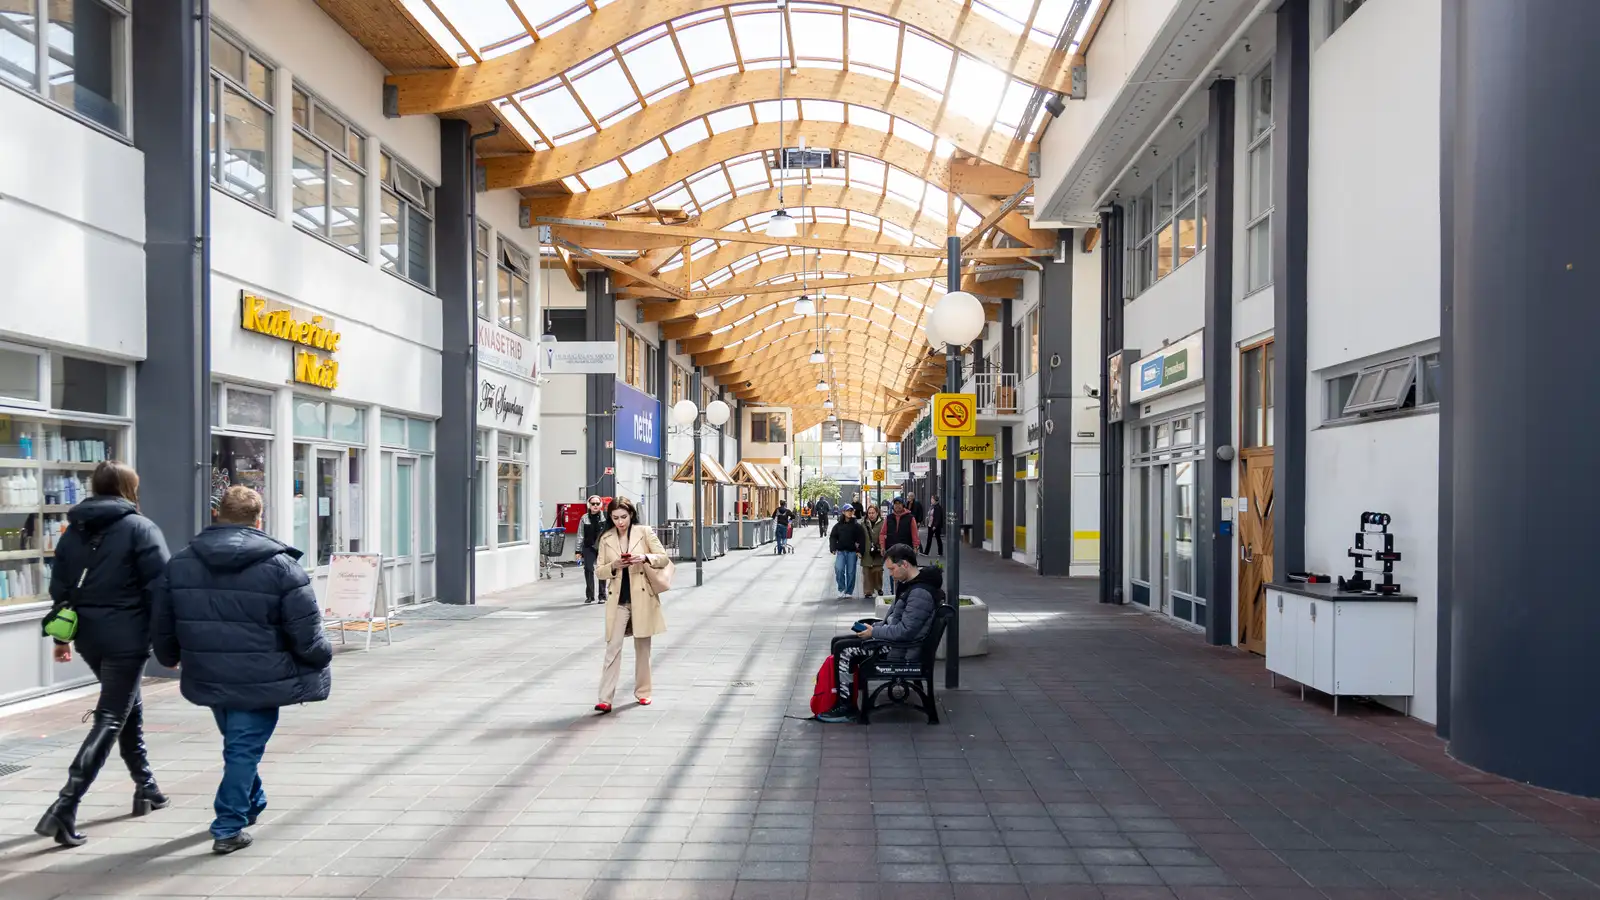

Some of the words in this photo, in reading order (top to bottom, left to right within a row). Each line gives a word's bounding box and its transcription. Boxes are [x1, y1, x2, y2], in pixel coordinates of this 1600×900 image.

[243, 294, 341, 352] Katherine
[296, 350, 339, 390] Nail
[634, 411, 653, 444] nettó
[942, 444, 987, 452] Aekarinn
